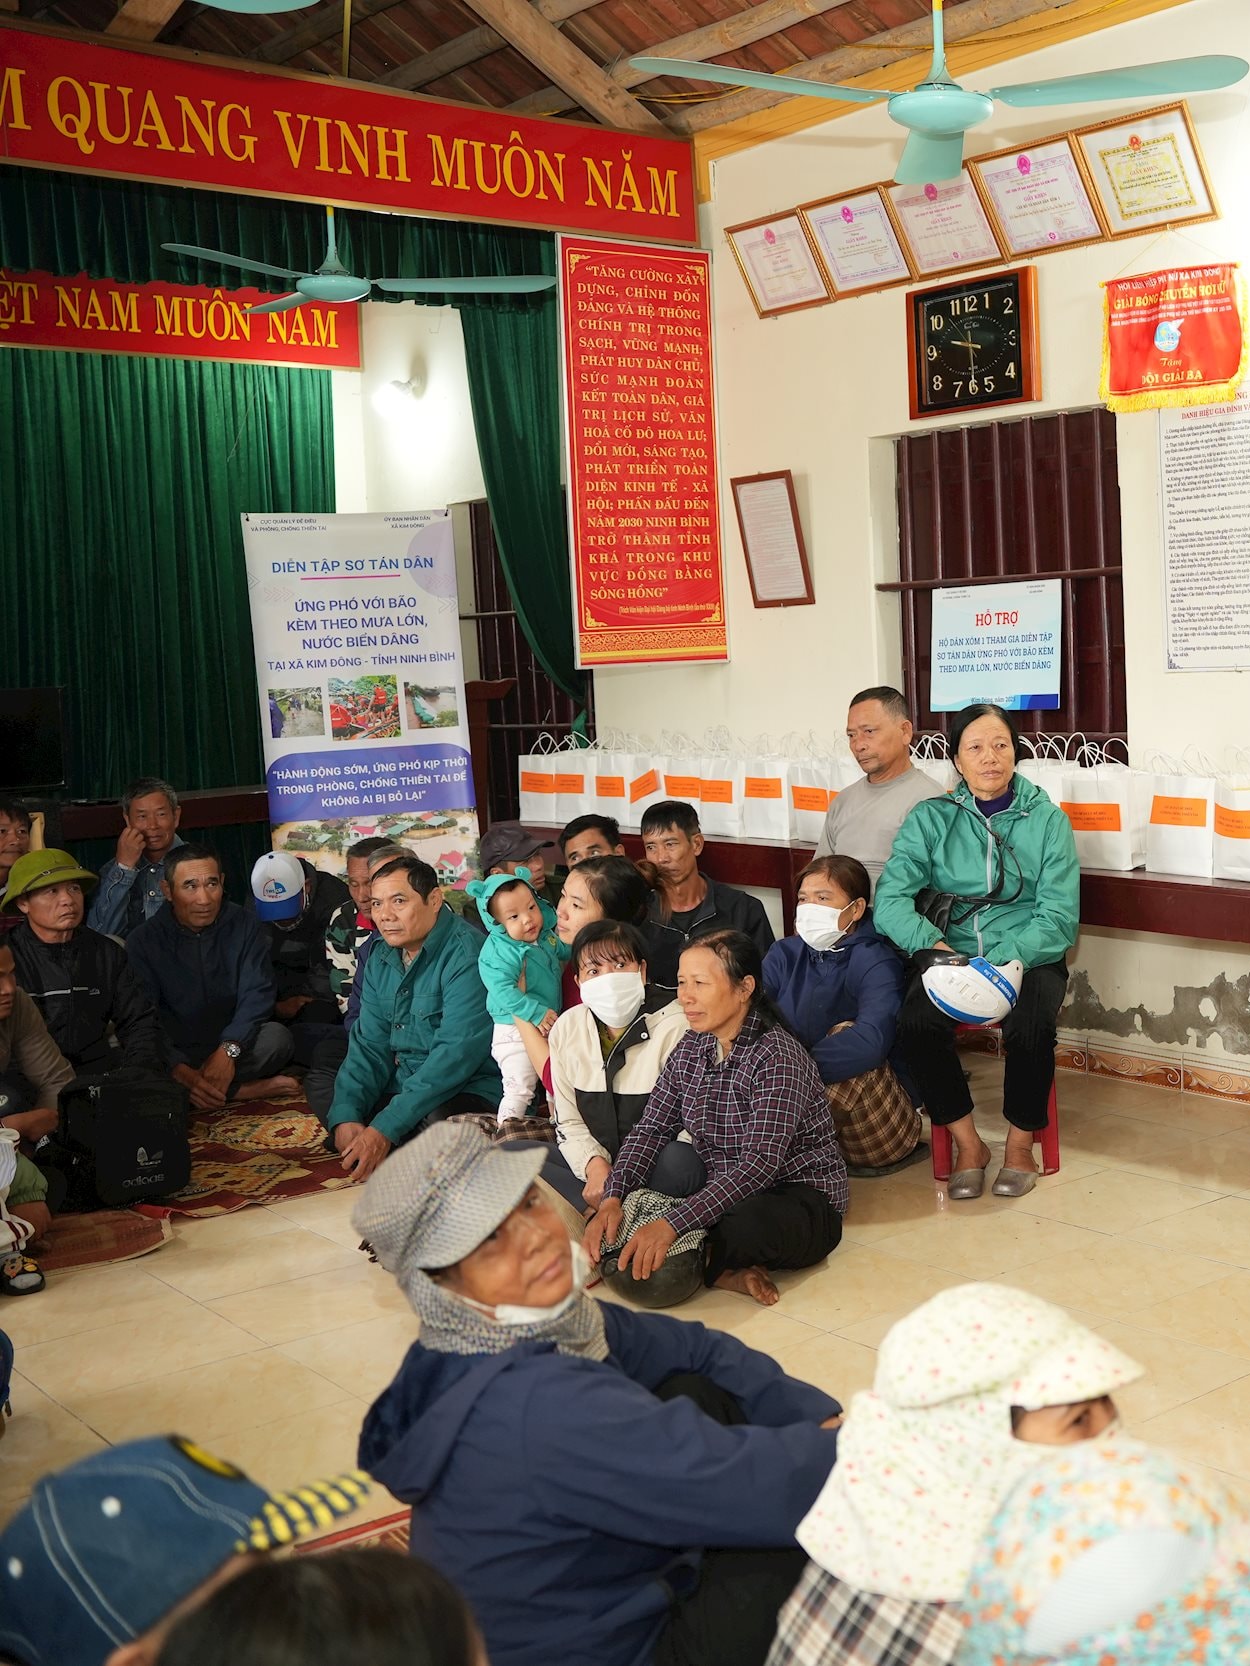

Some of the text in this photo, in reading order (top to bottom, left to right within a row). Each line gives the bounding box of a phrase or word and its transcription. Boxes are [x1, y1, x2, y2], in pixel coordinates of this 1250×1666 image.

[46, 76, 258, 164] QUANG
[272, 110, 411, 182] VINH
[427, 130, 566, 202] MUÔN
[582, 148, 681, 217] NĂM
[630, 268, 672, 283] CƯỜNG
[676, 272, 699, 285] XÂY
[577, 282, 618, 297] DỰNG,
[626, 285, 666, 300] CHỈNH
[950, 299, 960, 316] 11
[963, 296, 977, 312] 12
[984, 293, 989, 308] 1
[1003, 298, 1013, 314] 2
[55, 285, 141, 333] NAM
[153, 290, 252, 342] MUÔN
[618, 302, 634, 314] VÀ
[638, 303, 655, 318] HỆ
[658, 305, 700, 320] THỐNG
[579, 318, 701, 337] CHÍNH TRỊ TRONG
[930, 315, 943, 331] 10
[1009, 330, 1016, 345] 3
[928, 346, 937, 360] 9
[1005, 362, 1015, 378] 4
[1163, 368, 1202, 382] GIẢI BA
[933, 375, 943, 390] 8
[953, 382, 963, 397] 7
[969, 377, 978, 395] 6
[984, 376, 995, 392] 5
[1182, 411, 1197, 419] DANH
[311, 558, 340, 574] TẬP
[345, 560, 364, 571] SƠ
[369, 556, 399, 570] TÁN
[404, 555, 433, 569] DÂN
[295, 595, 416, 612] ỨNG PHÓ VỚI BÃO
[287, 613, 428, 631] KÈM THEO MƯA LỚN,
[995, 611, 1018, 626] TRỢ
[303, 635, 342, 649] NƯỚC
[382, 632, 419, 646] DÂNG
[986, 636, 1006, 644] THAM
[1008, 635, 1020, 643] GIA
[268, 661, 285, 672] TẠI
[307, 659, 327, 668] KIM
[330, 656, 362, 667] ĐÔNG
[401, 654, 426, 664] NINH
[430, 652, 455, 662] BÌNH
[310, 766, 341, 778] ĐỘNG
[344, 764, 370, 776] SỚM,
[373, 761, 396, 773] ỨNG
[399, 759, 421, 772] PHÓ
[424, 759, 440, 771] KỊP
[277, 784, 313, 795] TRONG
[317, 781, 357, 794] PHÒNG,
[360, 777, 397, 789] CHỐNG
[400, 773, 431, 786] THIÊN
[434, 774, 450, 783] TAI
[322, 794, 359, 807] KHÔNG
[363, 795, 372, 804] AI
[376, 795, 386, 804] BỊ
[388, 790, 402, 801] BỎ
